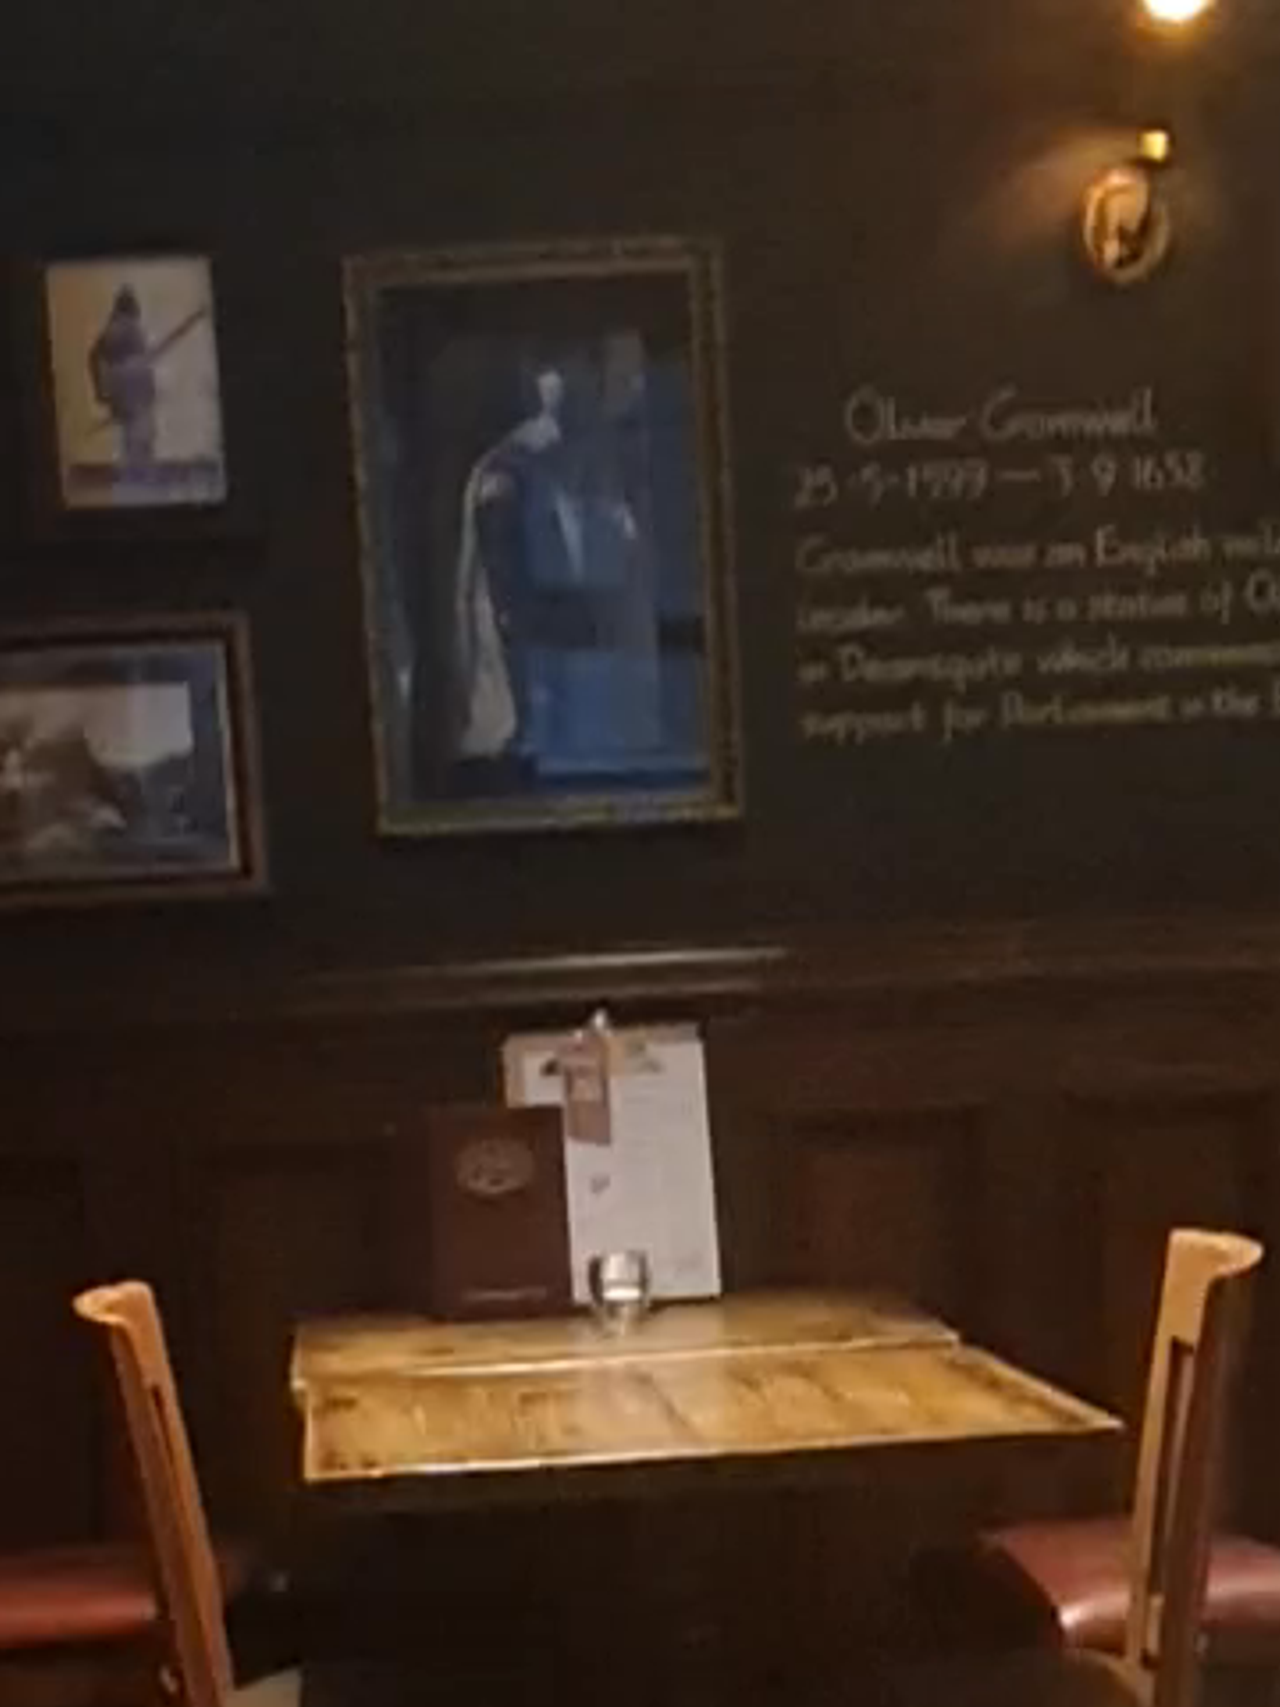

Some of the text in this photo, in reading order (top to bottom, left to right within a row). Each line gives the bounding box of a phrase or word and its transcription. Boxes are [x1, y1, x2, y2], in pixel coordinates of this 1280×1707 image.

[844, 383, 1158, 444] Oliver Cromwell
[796, 533, 962, 573] Cromwell
[1096, 525, 1212, 577] English
